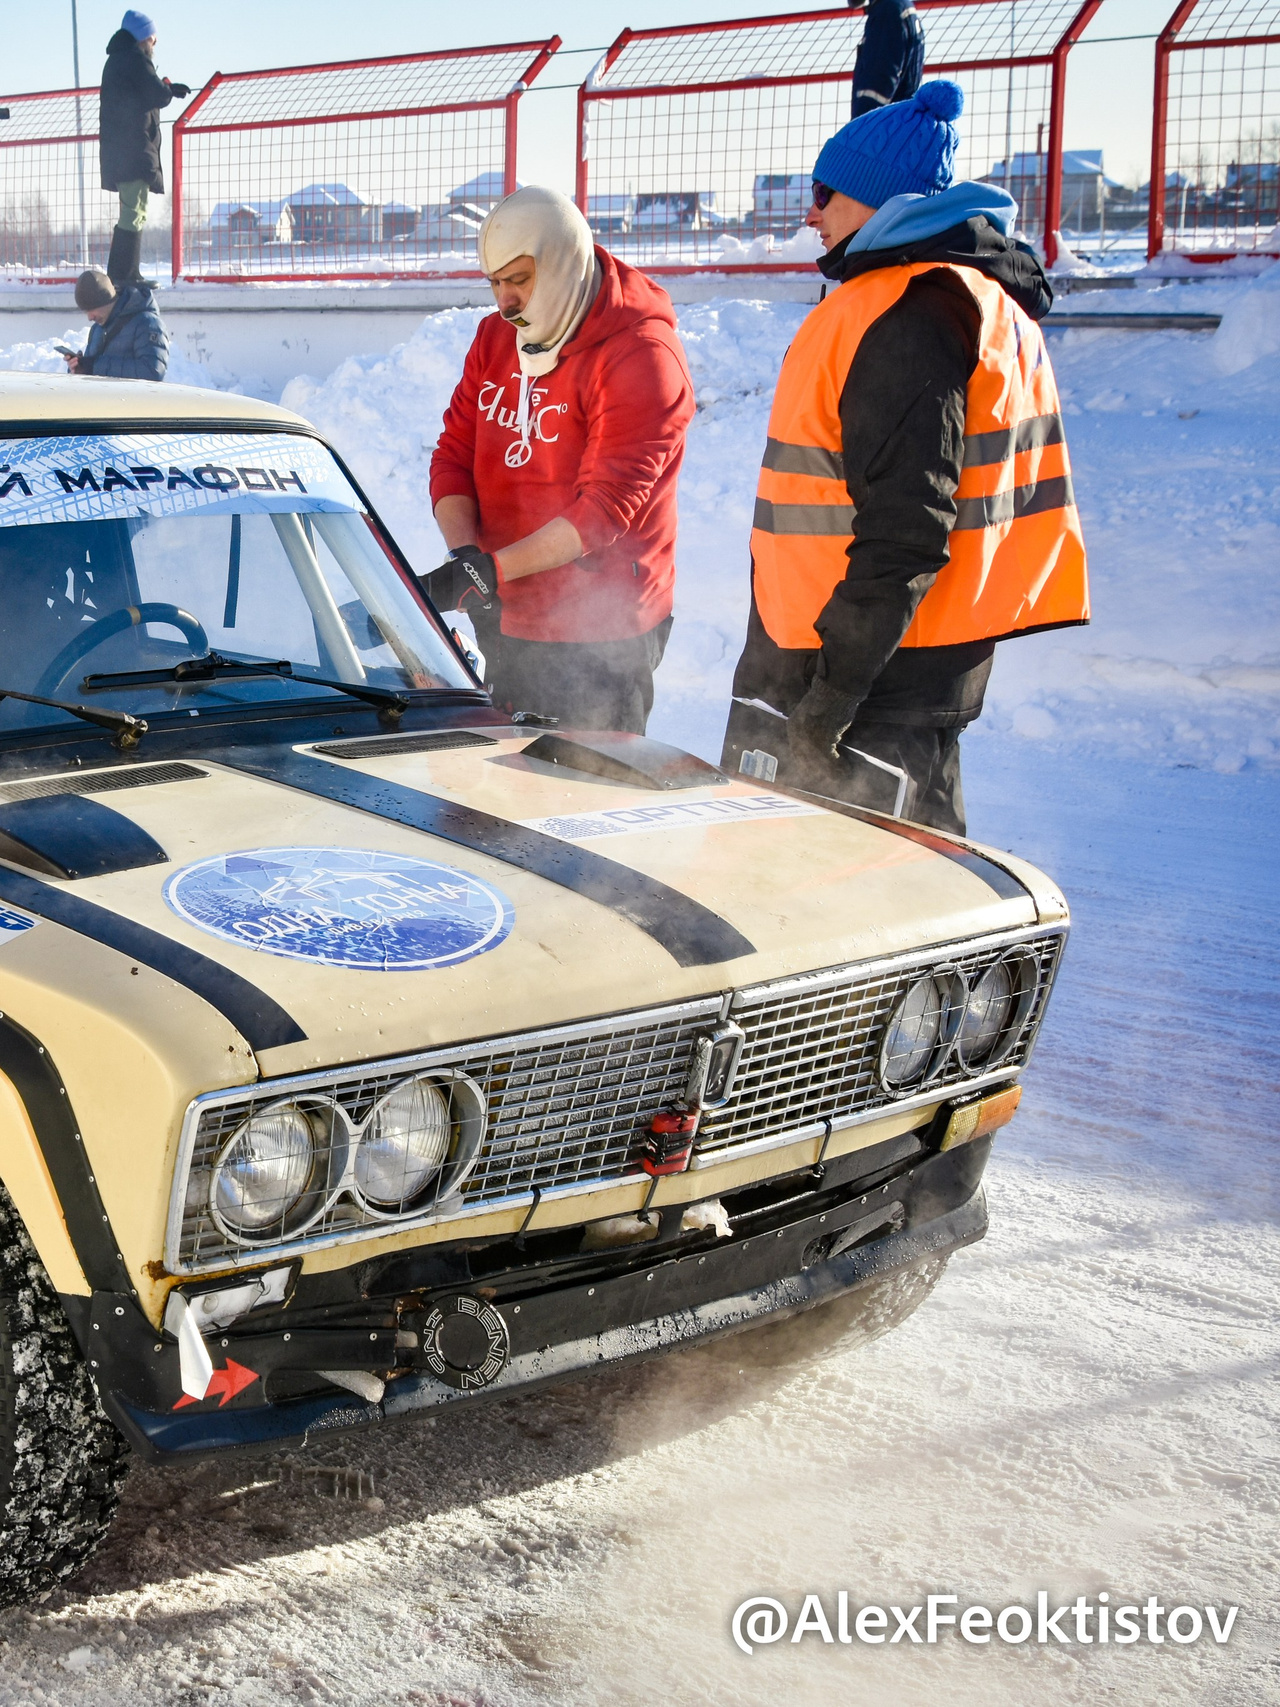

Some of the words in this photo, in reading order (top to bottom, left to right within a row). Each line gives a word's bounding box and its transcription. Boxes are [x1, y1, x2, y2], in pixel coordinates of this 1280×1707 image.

[53, 463, 308, 494] МАРАФОН
[602, 796, 801, 824] OPTTILE
[231, 904, 354, 941] ОДНА
[342, 881, 481, 913] ТОННА
